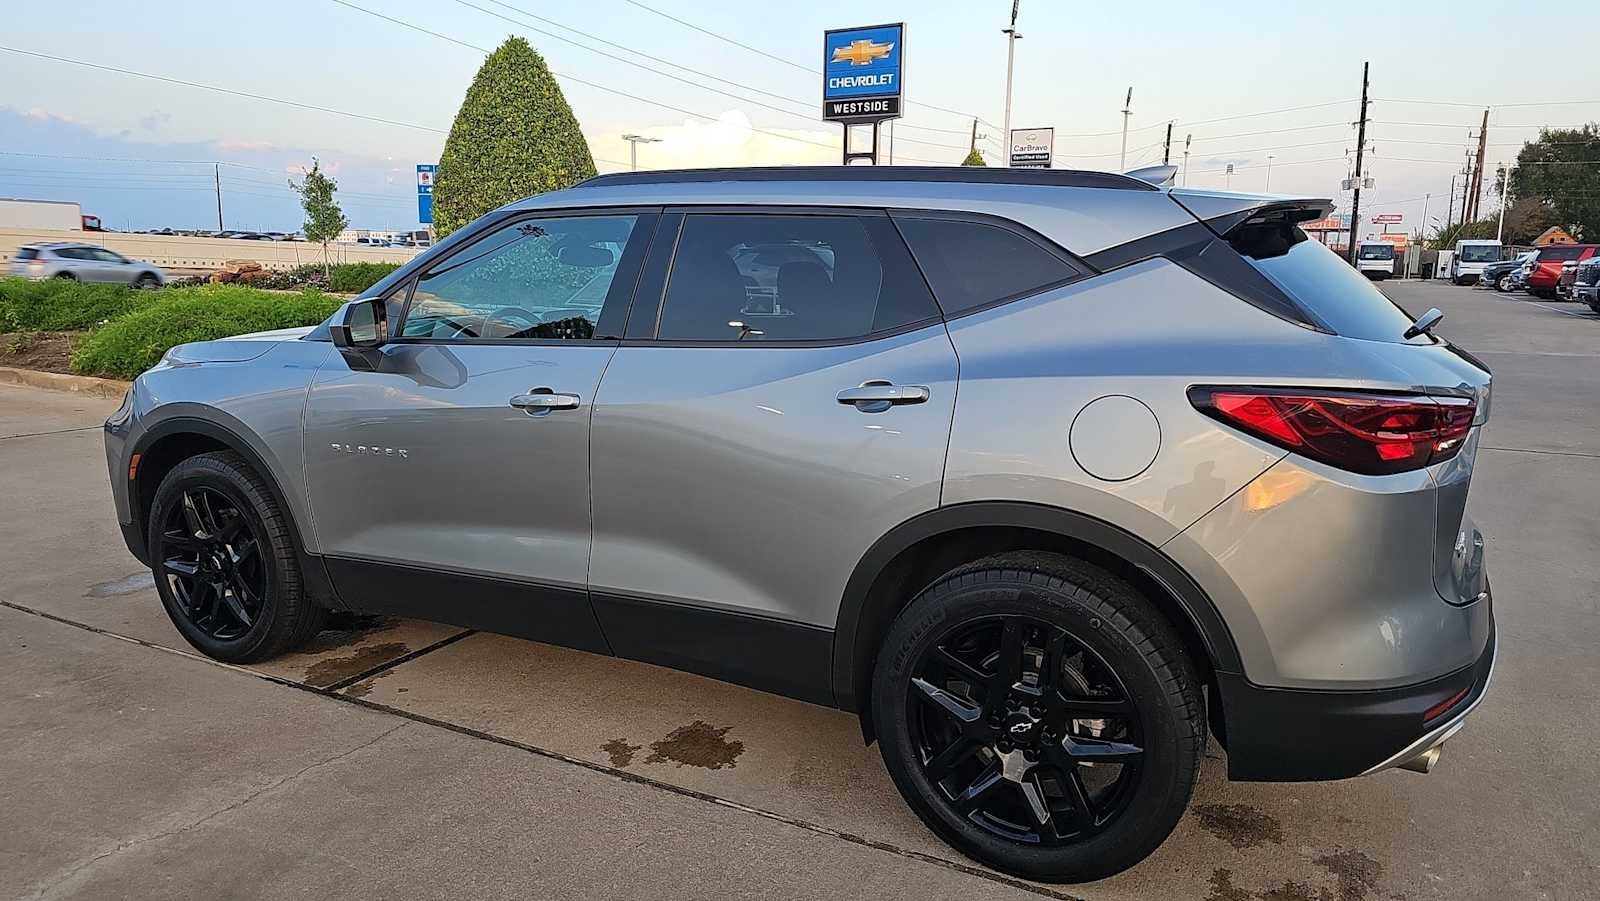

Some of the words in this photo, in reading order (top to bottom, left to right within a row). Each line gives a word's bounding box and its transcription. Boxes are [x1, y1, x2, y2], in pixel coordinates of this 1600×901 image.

[829, 74, 894, 89] CHEVROLET
[834, 101, 889, 114] WESTSIDE
[1013, 144, 1048, 152] CarBravo
